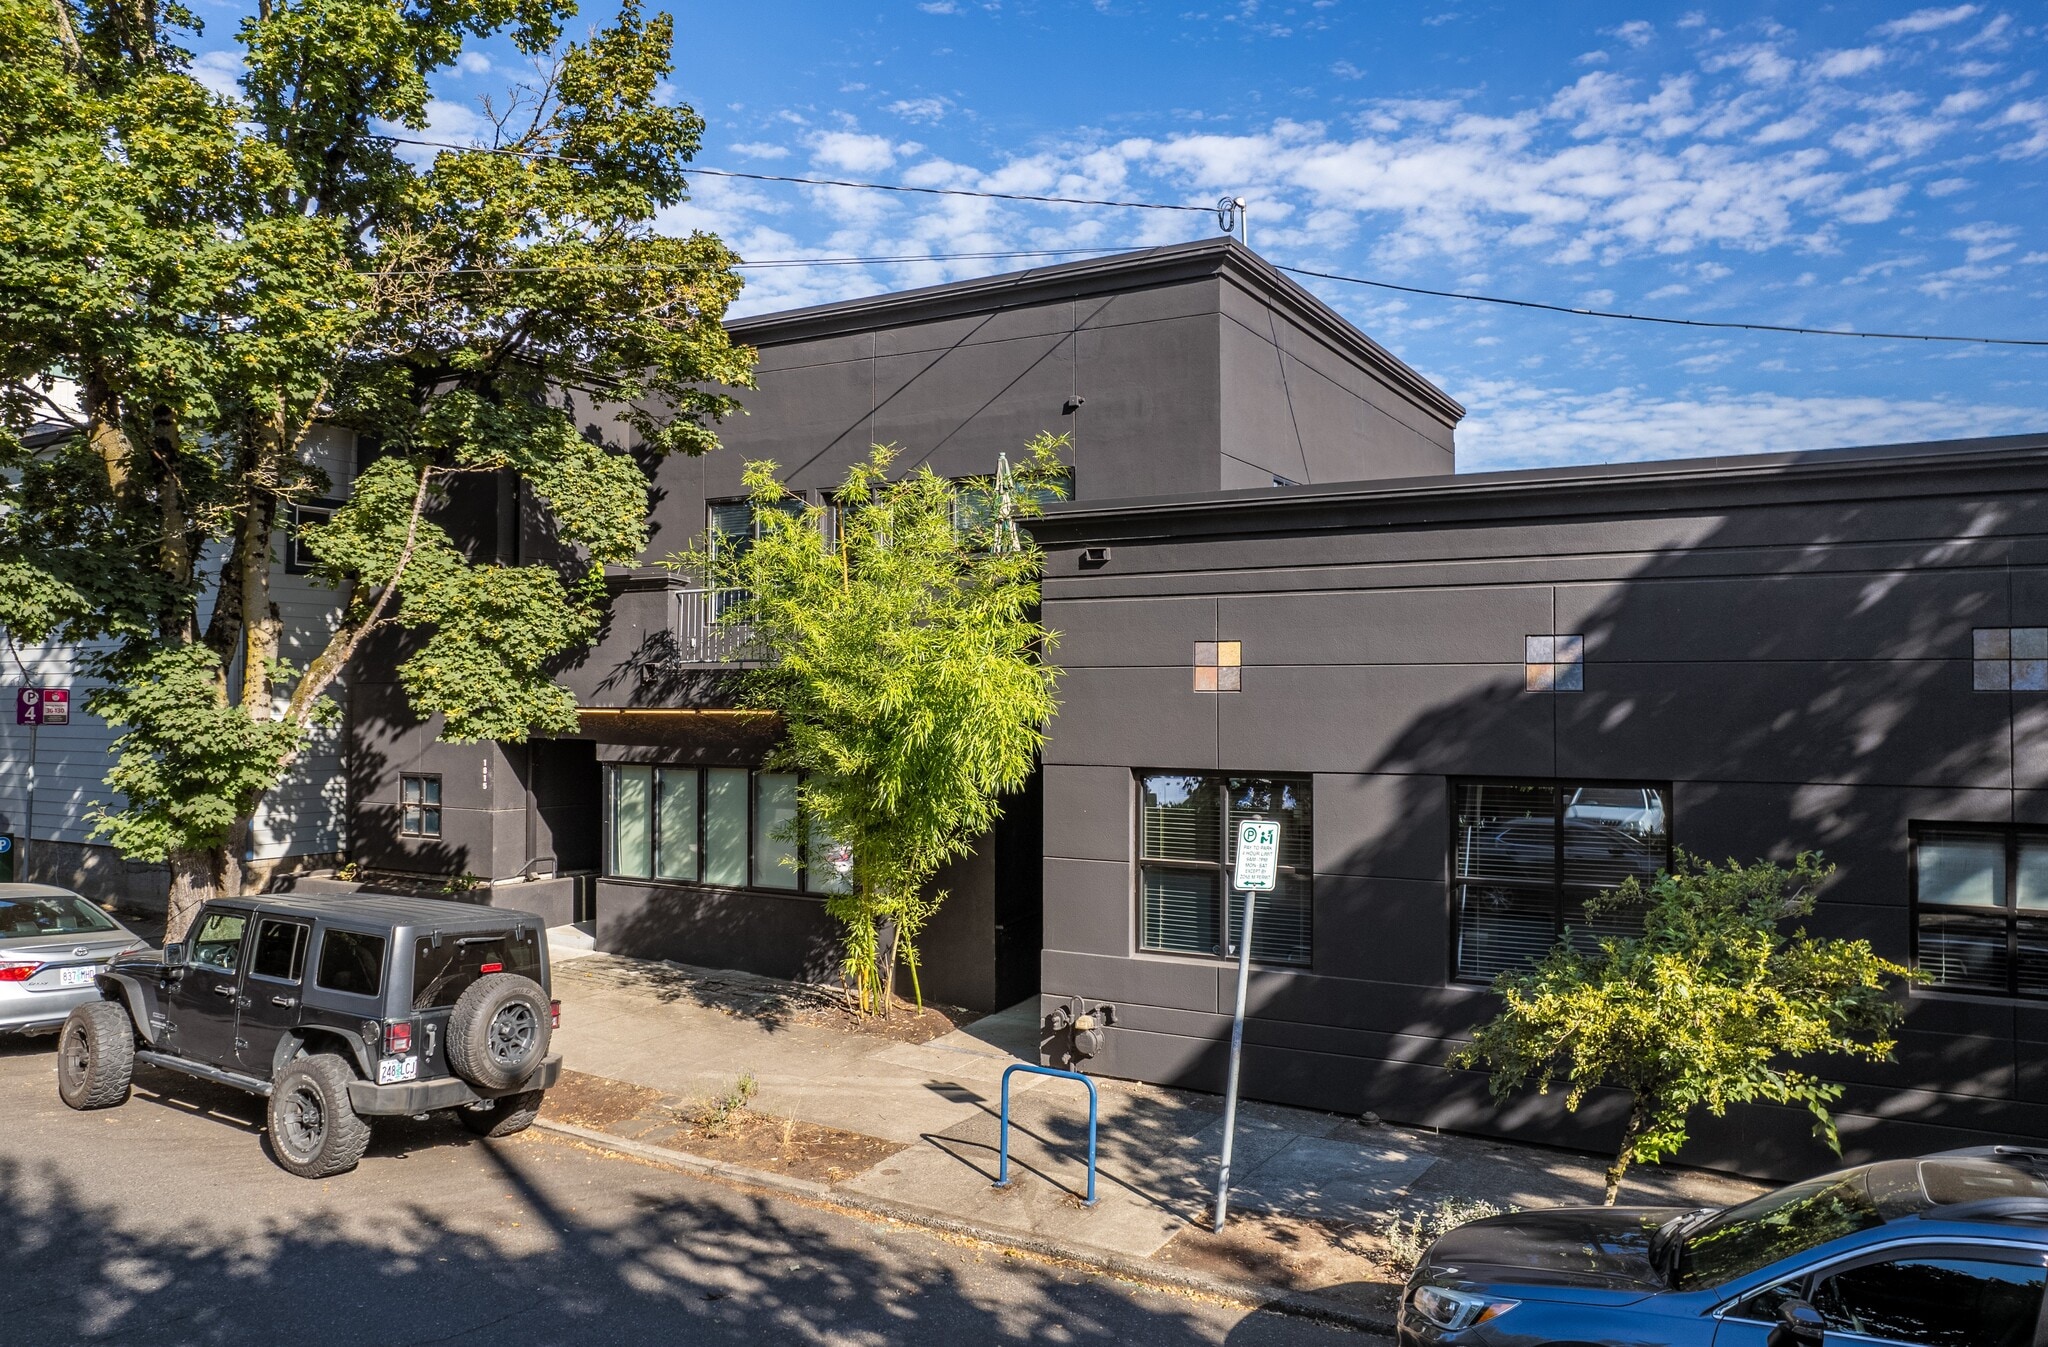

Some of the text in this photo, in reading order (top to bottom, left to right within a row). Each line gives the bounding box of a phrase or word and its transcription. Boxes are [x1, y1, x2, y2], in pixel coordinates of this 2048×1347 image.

[27, 692, 35, 702] P
[24, 706, 36, 720] 4
[62, 971, 77, 982] 837
[382, 1065, 396, 1079] 248
